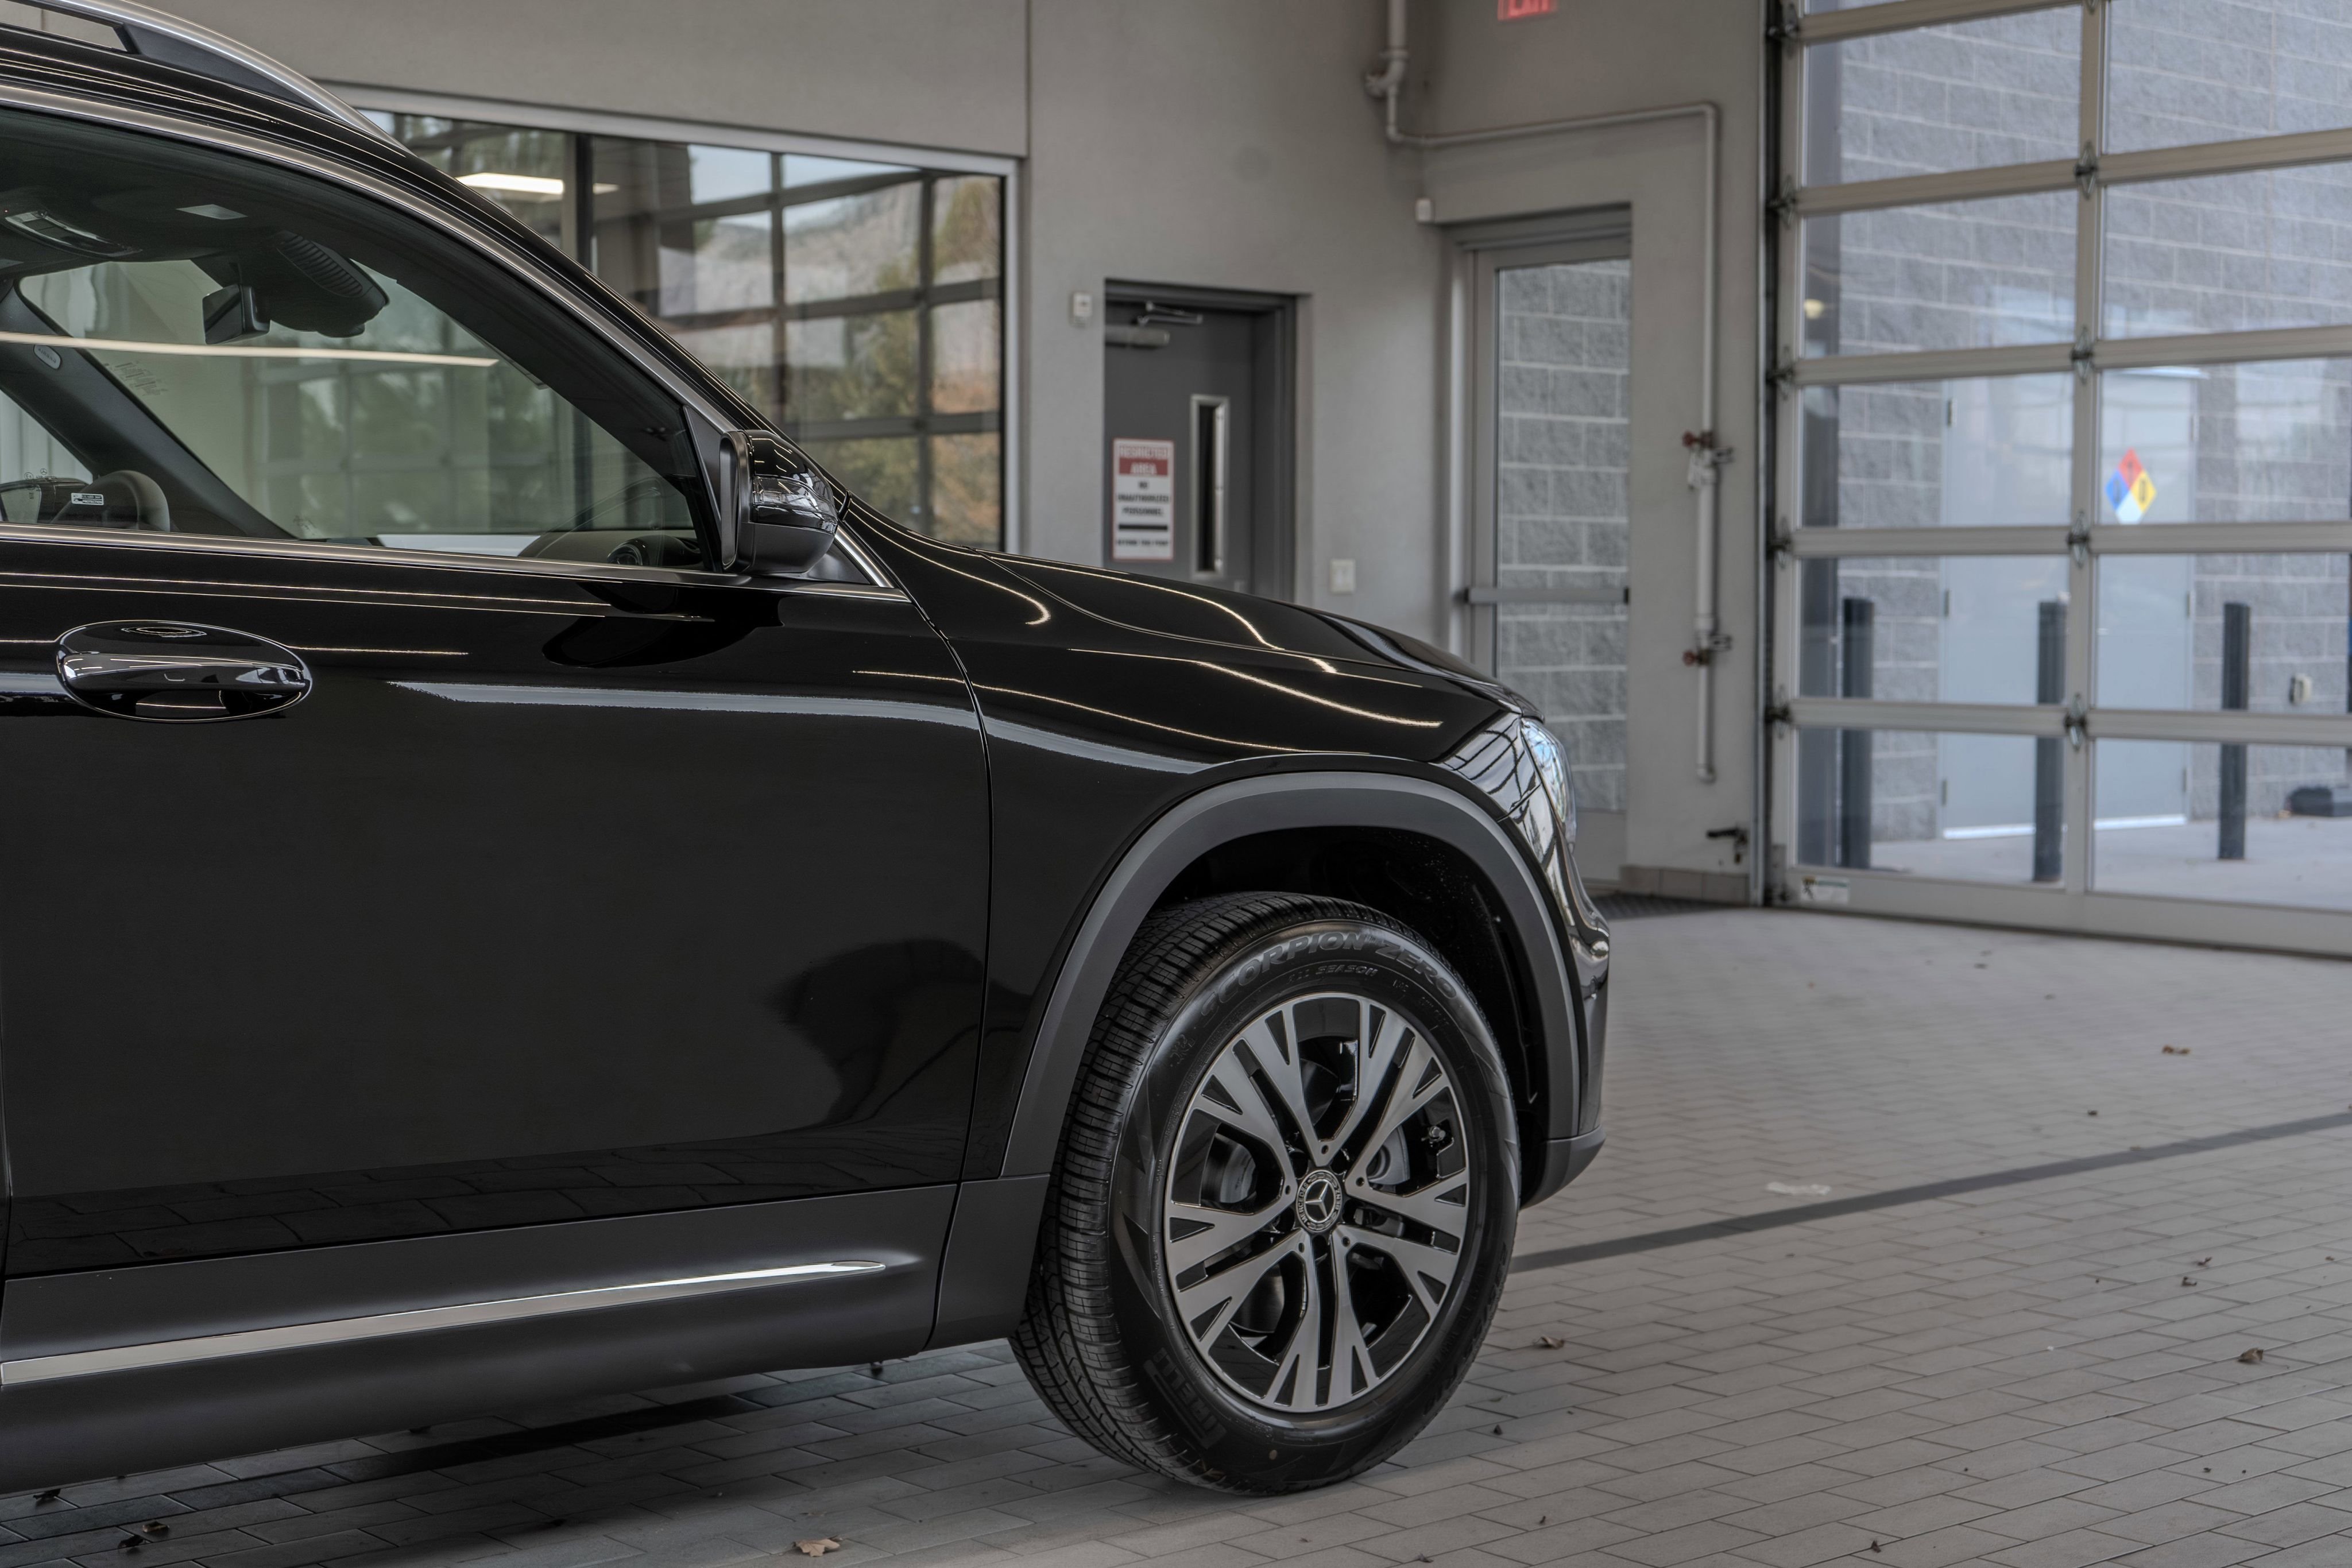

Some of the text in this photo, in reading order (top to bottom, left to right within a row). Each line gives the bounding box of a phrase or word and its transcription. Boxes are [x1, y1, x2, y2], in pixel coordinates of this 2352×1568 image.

[1130, 462, 1157, 474] AREA
[1200, 931, 1366, 1028] SCORPION
[1375, 939, 1457, 999] ZERO
[1315, 964, 1379, 977] SEASON
[1298, 1183, 1309, 1224] MERCEDES
[1143, 1346, 1228, 1450] PIRELLI
